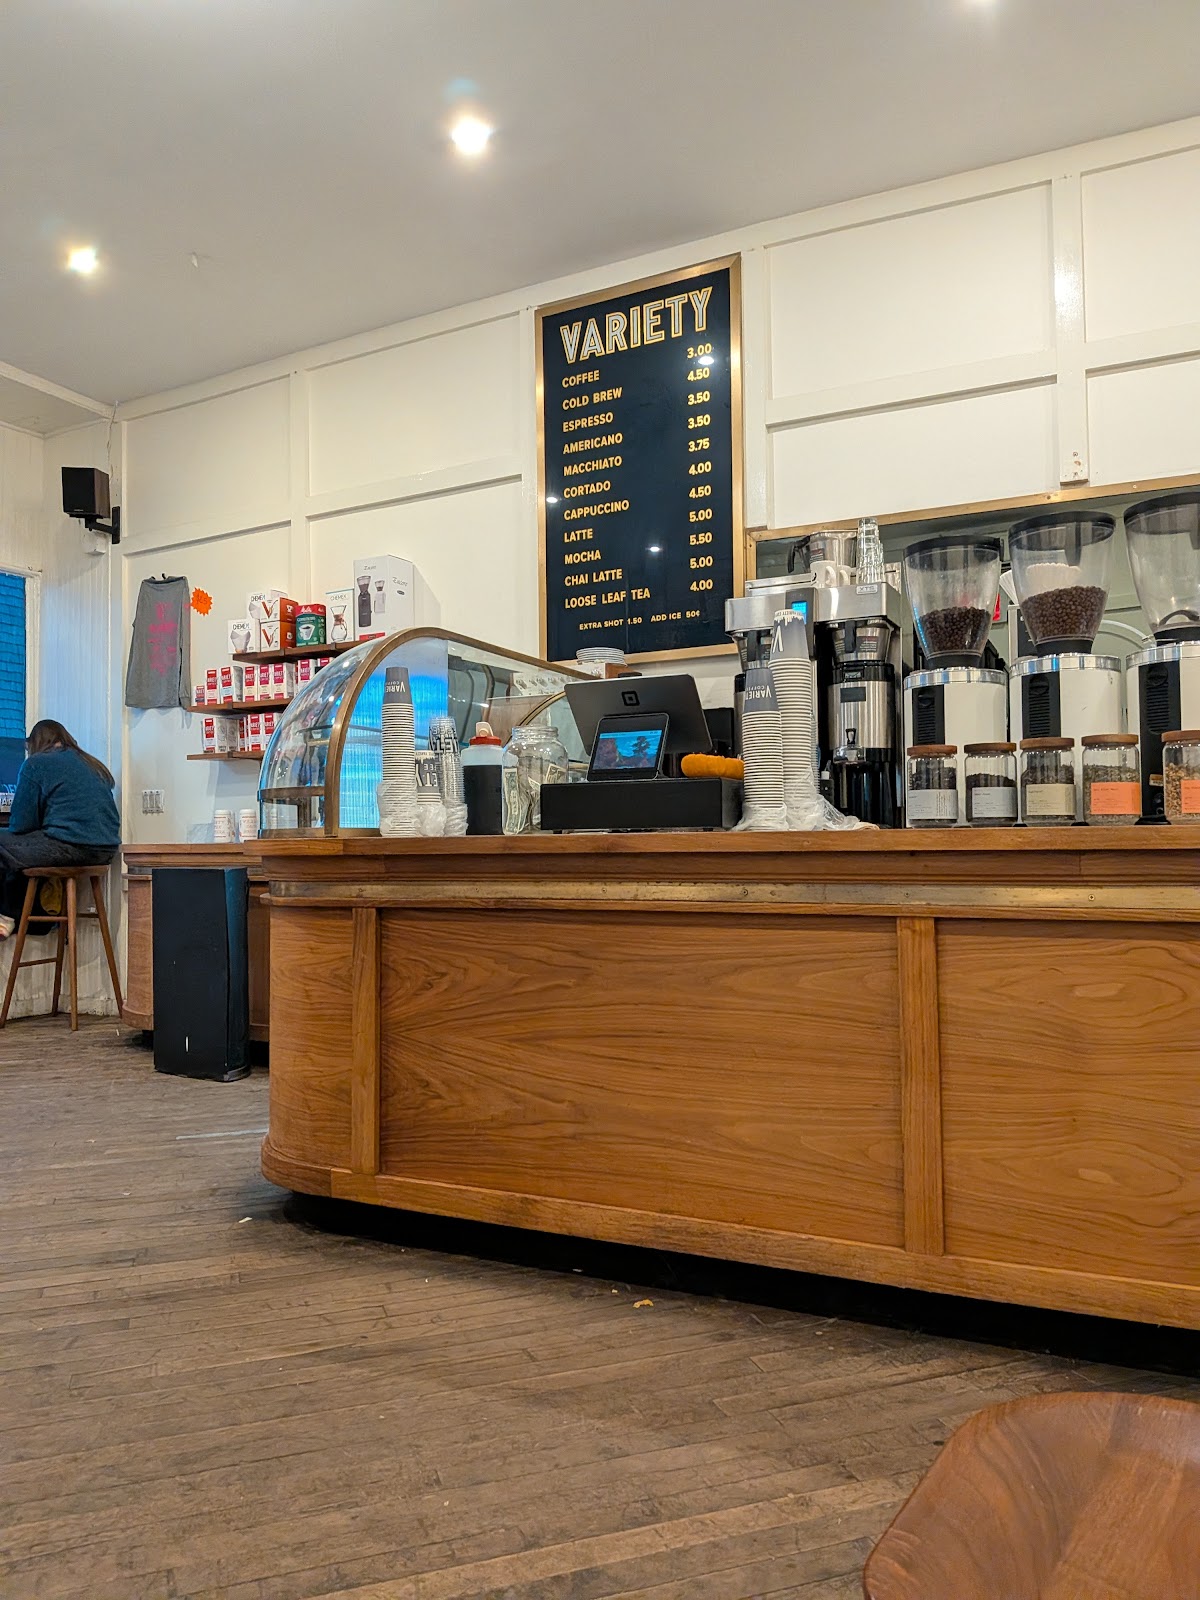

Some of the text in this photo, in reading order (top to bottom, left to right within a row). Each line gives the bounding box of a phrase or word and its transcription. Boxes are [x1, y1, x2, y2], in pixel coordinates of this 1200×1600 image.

[560, 286, 712, 364] VARIETY
[687, 344, 712, 358] 3.00
[562, 370, 599, 387] COFFEE
[687, 368, 710, 382] 4.50
[563, 387, 622, 410] COLD BREW
[688, 391, 710, 405] 3.50
[562, 412, 614, 432] ESPRESSO
[688, 414, 710, 429] 3.50
[562, 433, 623, 454] AMERICANO
[689, 438, 709, 452] 3.75
[563, 455, 623, 476] MACCHIATO
[689, 461, 711, 475] 4.00
[564, 481, 610, 498] CORTADO
[689, 485, 711, 498] 4.50
[564, 500, 630, 520] CAPPUCCINO
[690, 509, 712, 522] 5.00
[565, 529, 592, 542] LATTE
[690, 532, 712, 545] 5.50
[565, 550, 601, 564] MOCHA
[690, 556, 713, 568] 5.00
[565, 569, 622, 586] CHAI LATTE
[690, 579, 713, 591] 4.00
[566, 588, 650, 608] LOOSE LEAF TEA
[580, 622, 602, 630] EXTRA
[604, 619, 623, 627] SHOT
[746, 685, 772, 699] VARIET
